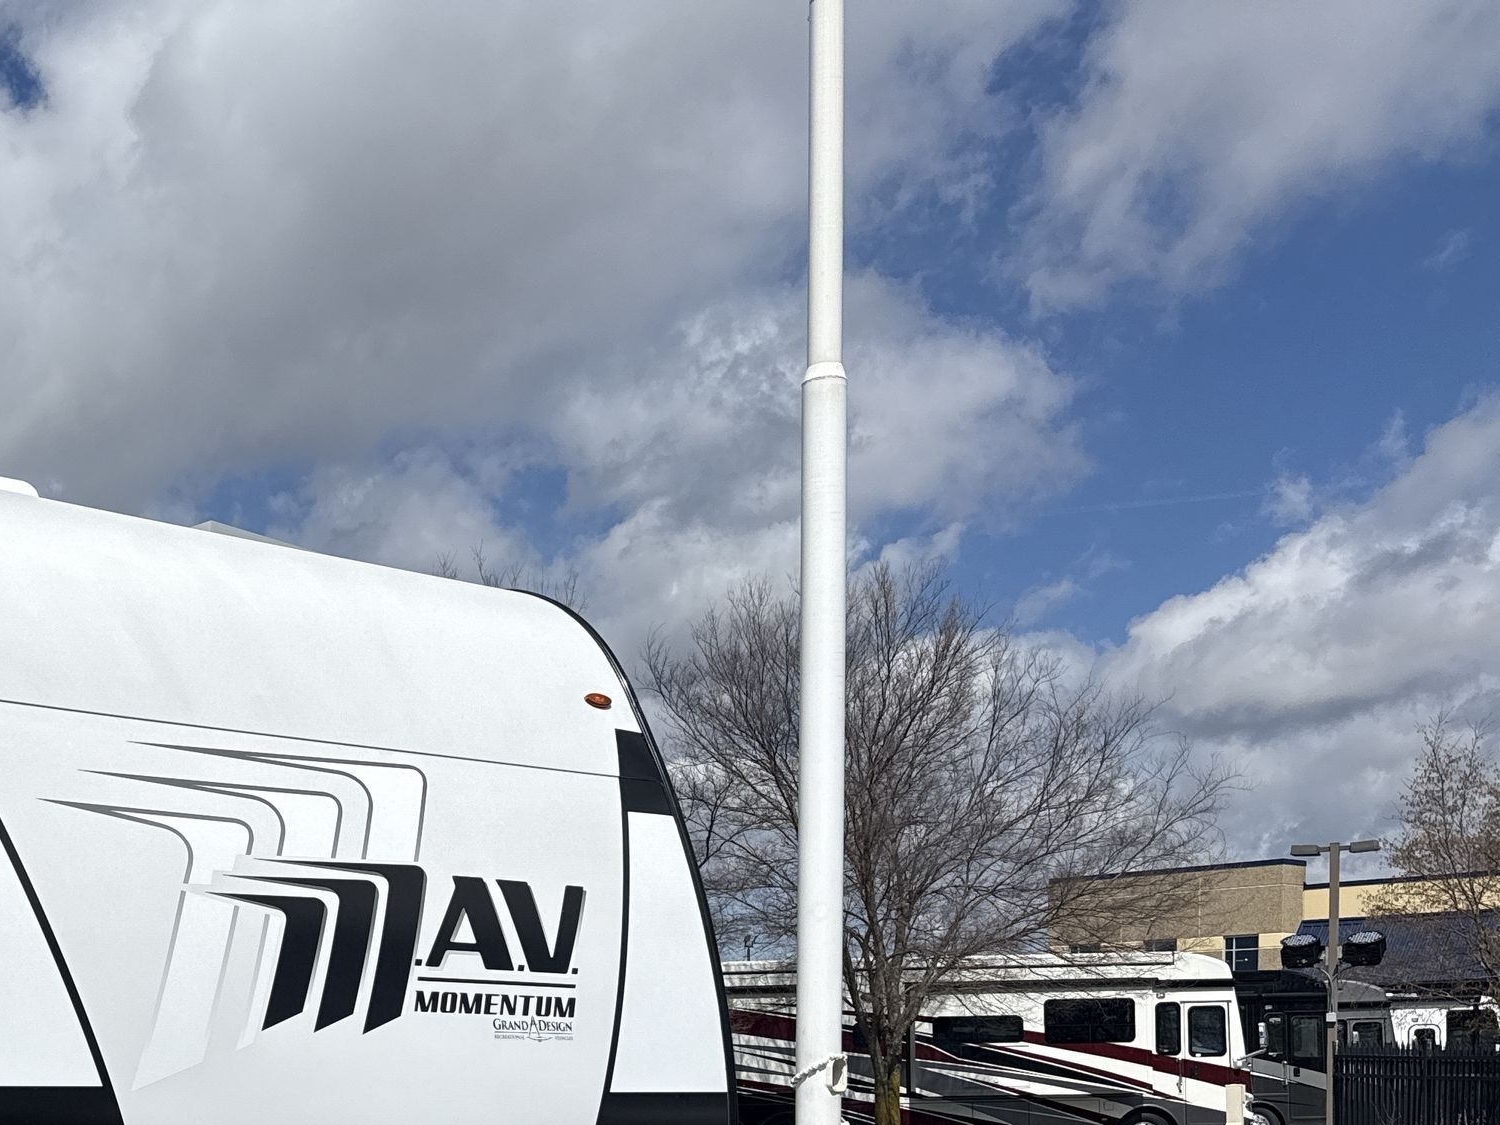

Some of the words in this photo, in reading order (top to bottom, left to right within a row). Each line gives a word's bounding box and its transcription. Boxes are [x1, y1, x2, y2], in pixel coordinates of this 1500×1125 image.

[414, 990, 576, 1018] MOMENTUM
[492, 1018, 529, 1031] GRAND
[538, 1019, 573, 1031] DESIGN
